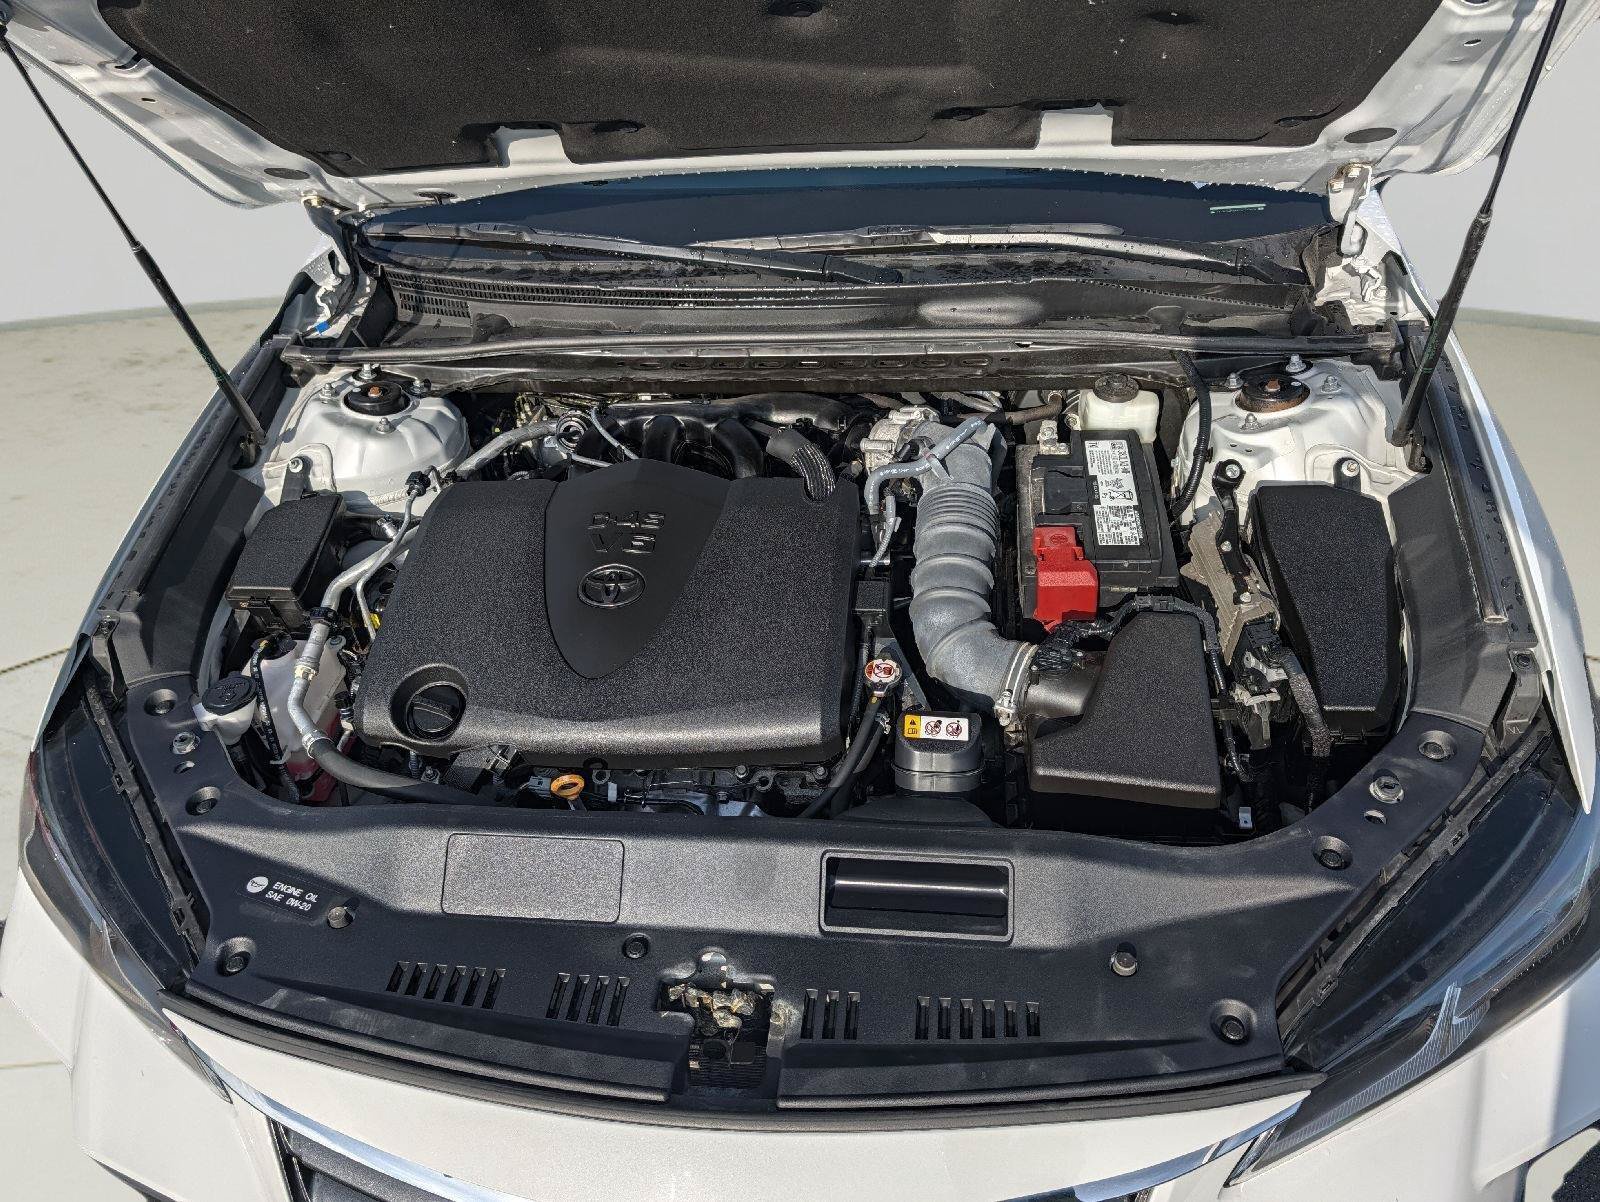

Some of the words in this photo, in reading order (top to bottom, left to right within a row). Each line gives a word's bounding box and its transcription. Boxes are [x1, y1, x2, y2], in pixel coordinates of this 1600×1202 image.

[265, 891, 285, 902] SAE
[272, 882, 304, 897] ENGINE
[305, 892, 318, 902] OIL
